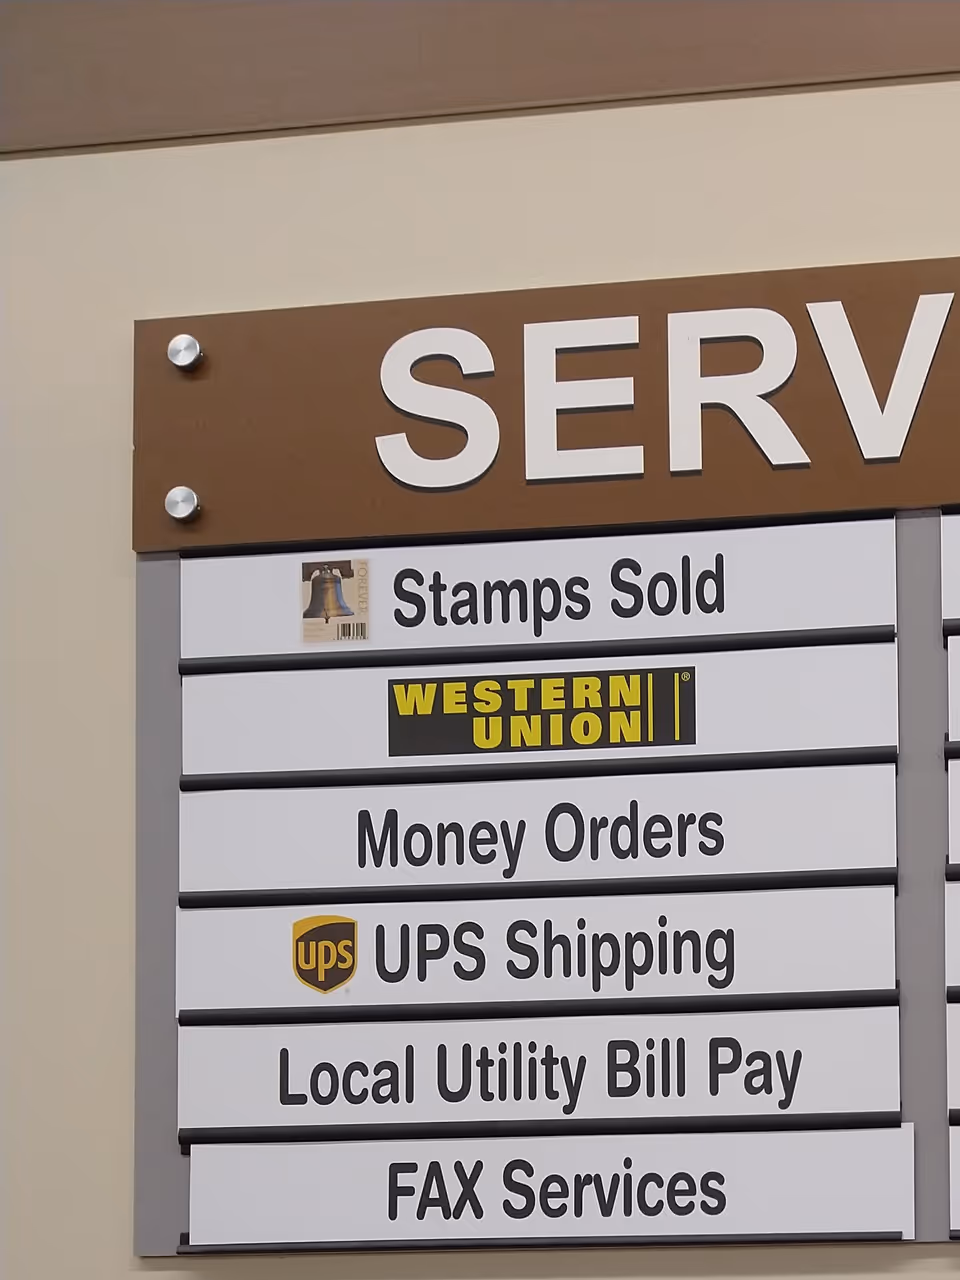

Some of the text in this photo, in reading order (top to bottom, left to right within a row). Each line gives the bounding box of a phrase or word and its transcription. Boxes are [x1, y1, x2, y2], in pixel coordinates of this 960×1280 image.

[392, 553, 726, 637] Stamps Sold
[394, 675, 640, 716] WESTERN
[473, 710, 640, 748] UNION
[357, 800, 724, 878] Money Orders
[298, 938, 354, 981] ups
[376, 916, 735, 991] UPS Shipping
[279, 1036, 802, 1114] Local Utility Bill Pay
[388, 1157, 727, 1220] FAX Services
